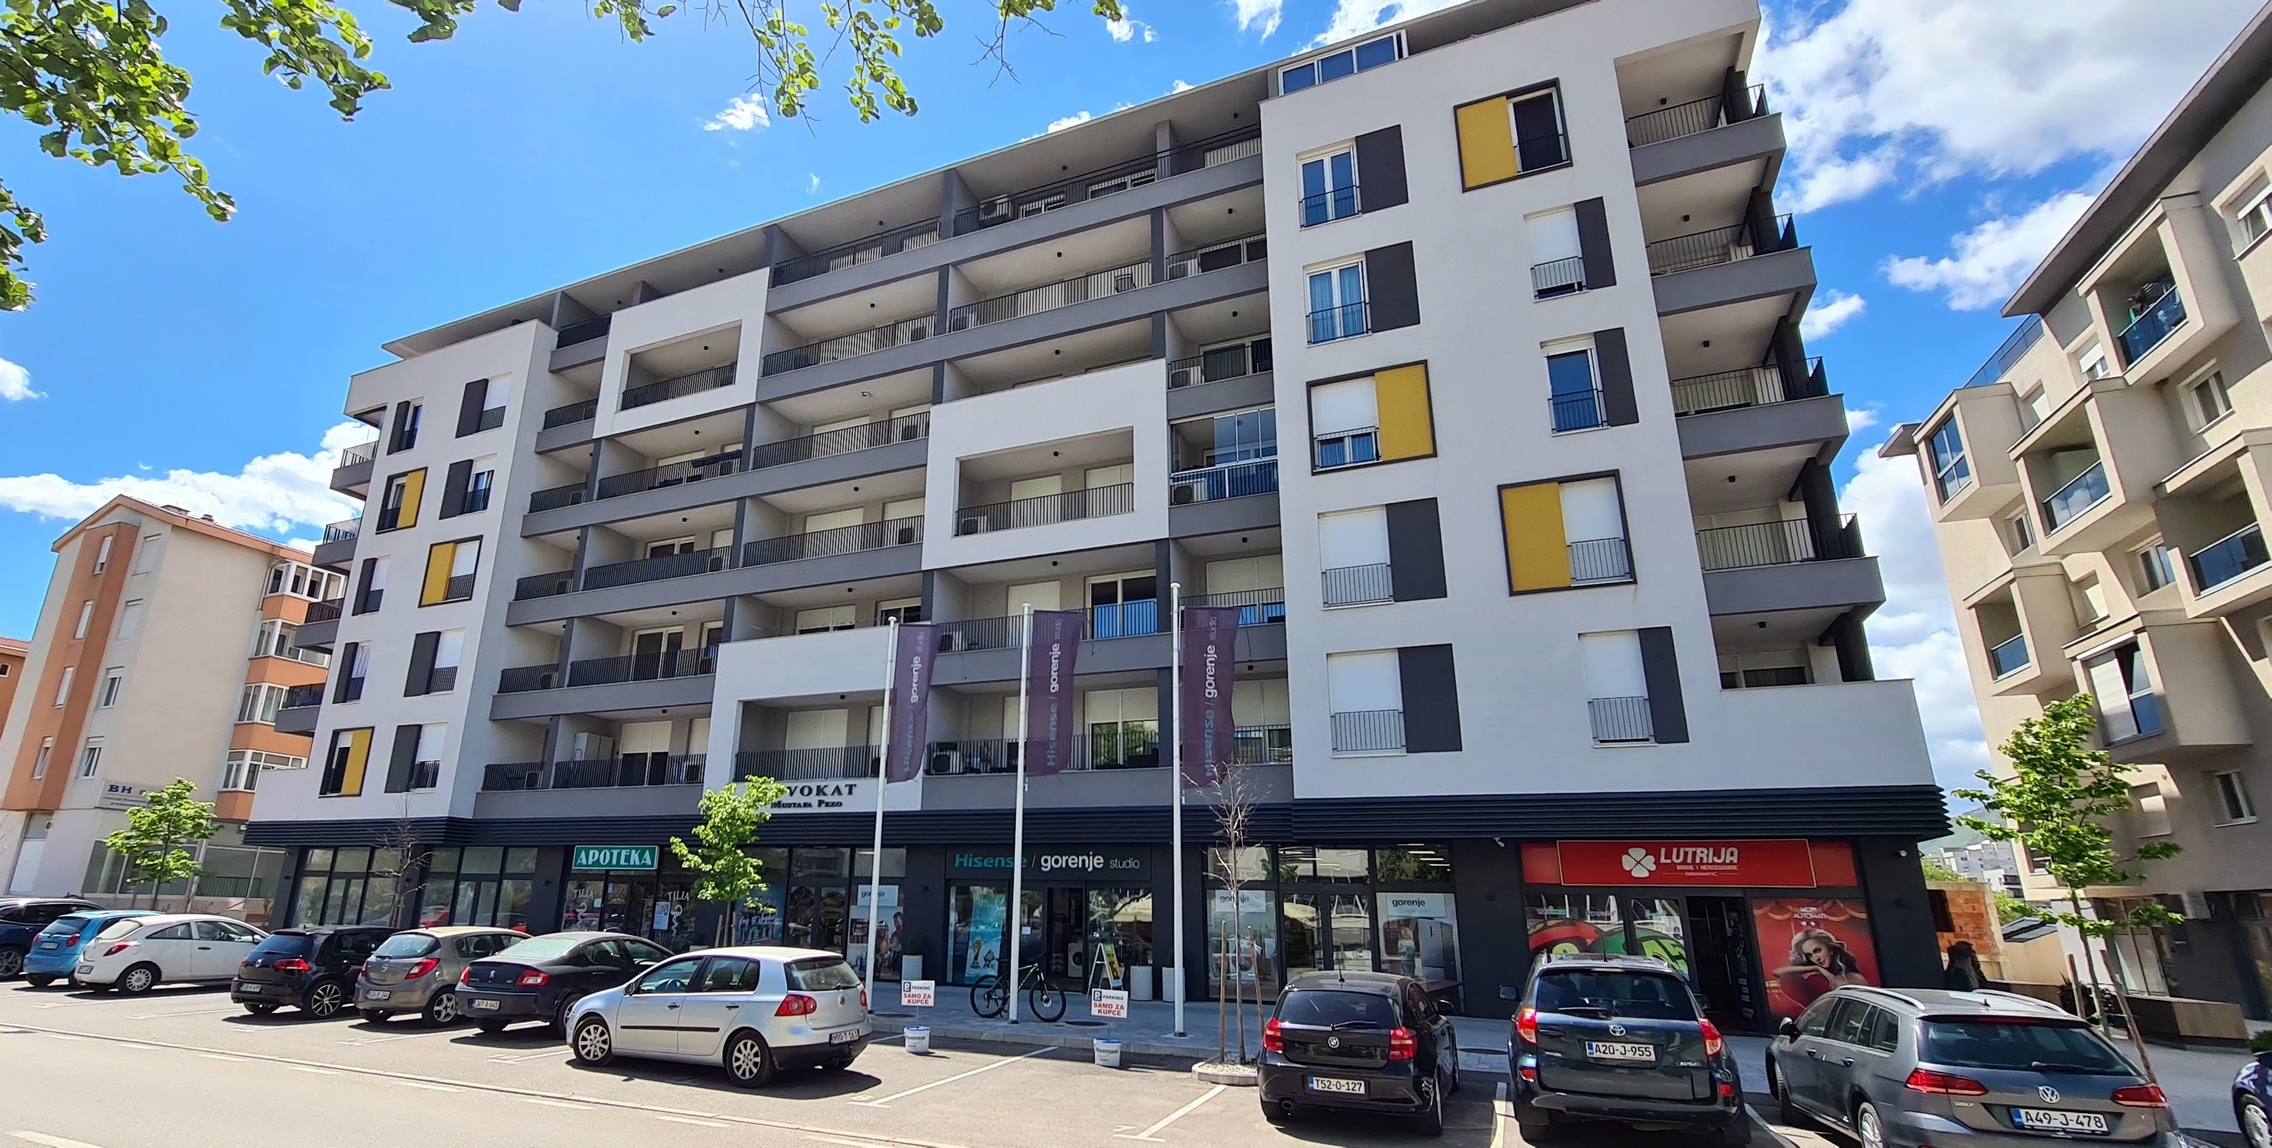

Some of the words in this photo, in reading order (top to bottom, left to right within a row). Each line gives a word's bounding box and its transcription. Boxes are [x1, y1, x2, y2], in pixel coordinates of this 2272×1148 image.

[1049, 643, 1062, 694] gorenje
[1203, 645, 1218, 699] gorenje
[910, 655, 922, 704] gorenje
[1046, 702, 1058, 767] Hisense
[108, 784, 133, 794] BH
[575, 849, 652, 866] APOTEKA
[1040, 851, 1104, 872] gorenje
[1109, 857, 1140, 869] studio
[1660, 847, 1739, 864] LUTRIJA
[573, 889, 594, 899] TILIA
[667, 891, 690, 902] TILIA
[1392, 897, 1426, 908] gorenje
[1595, 1044, 1652, 1057] A20-J-955
[2024, 1110, 2104, 1129] A49-J-478
